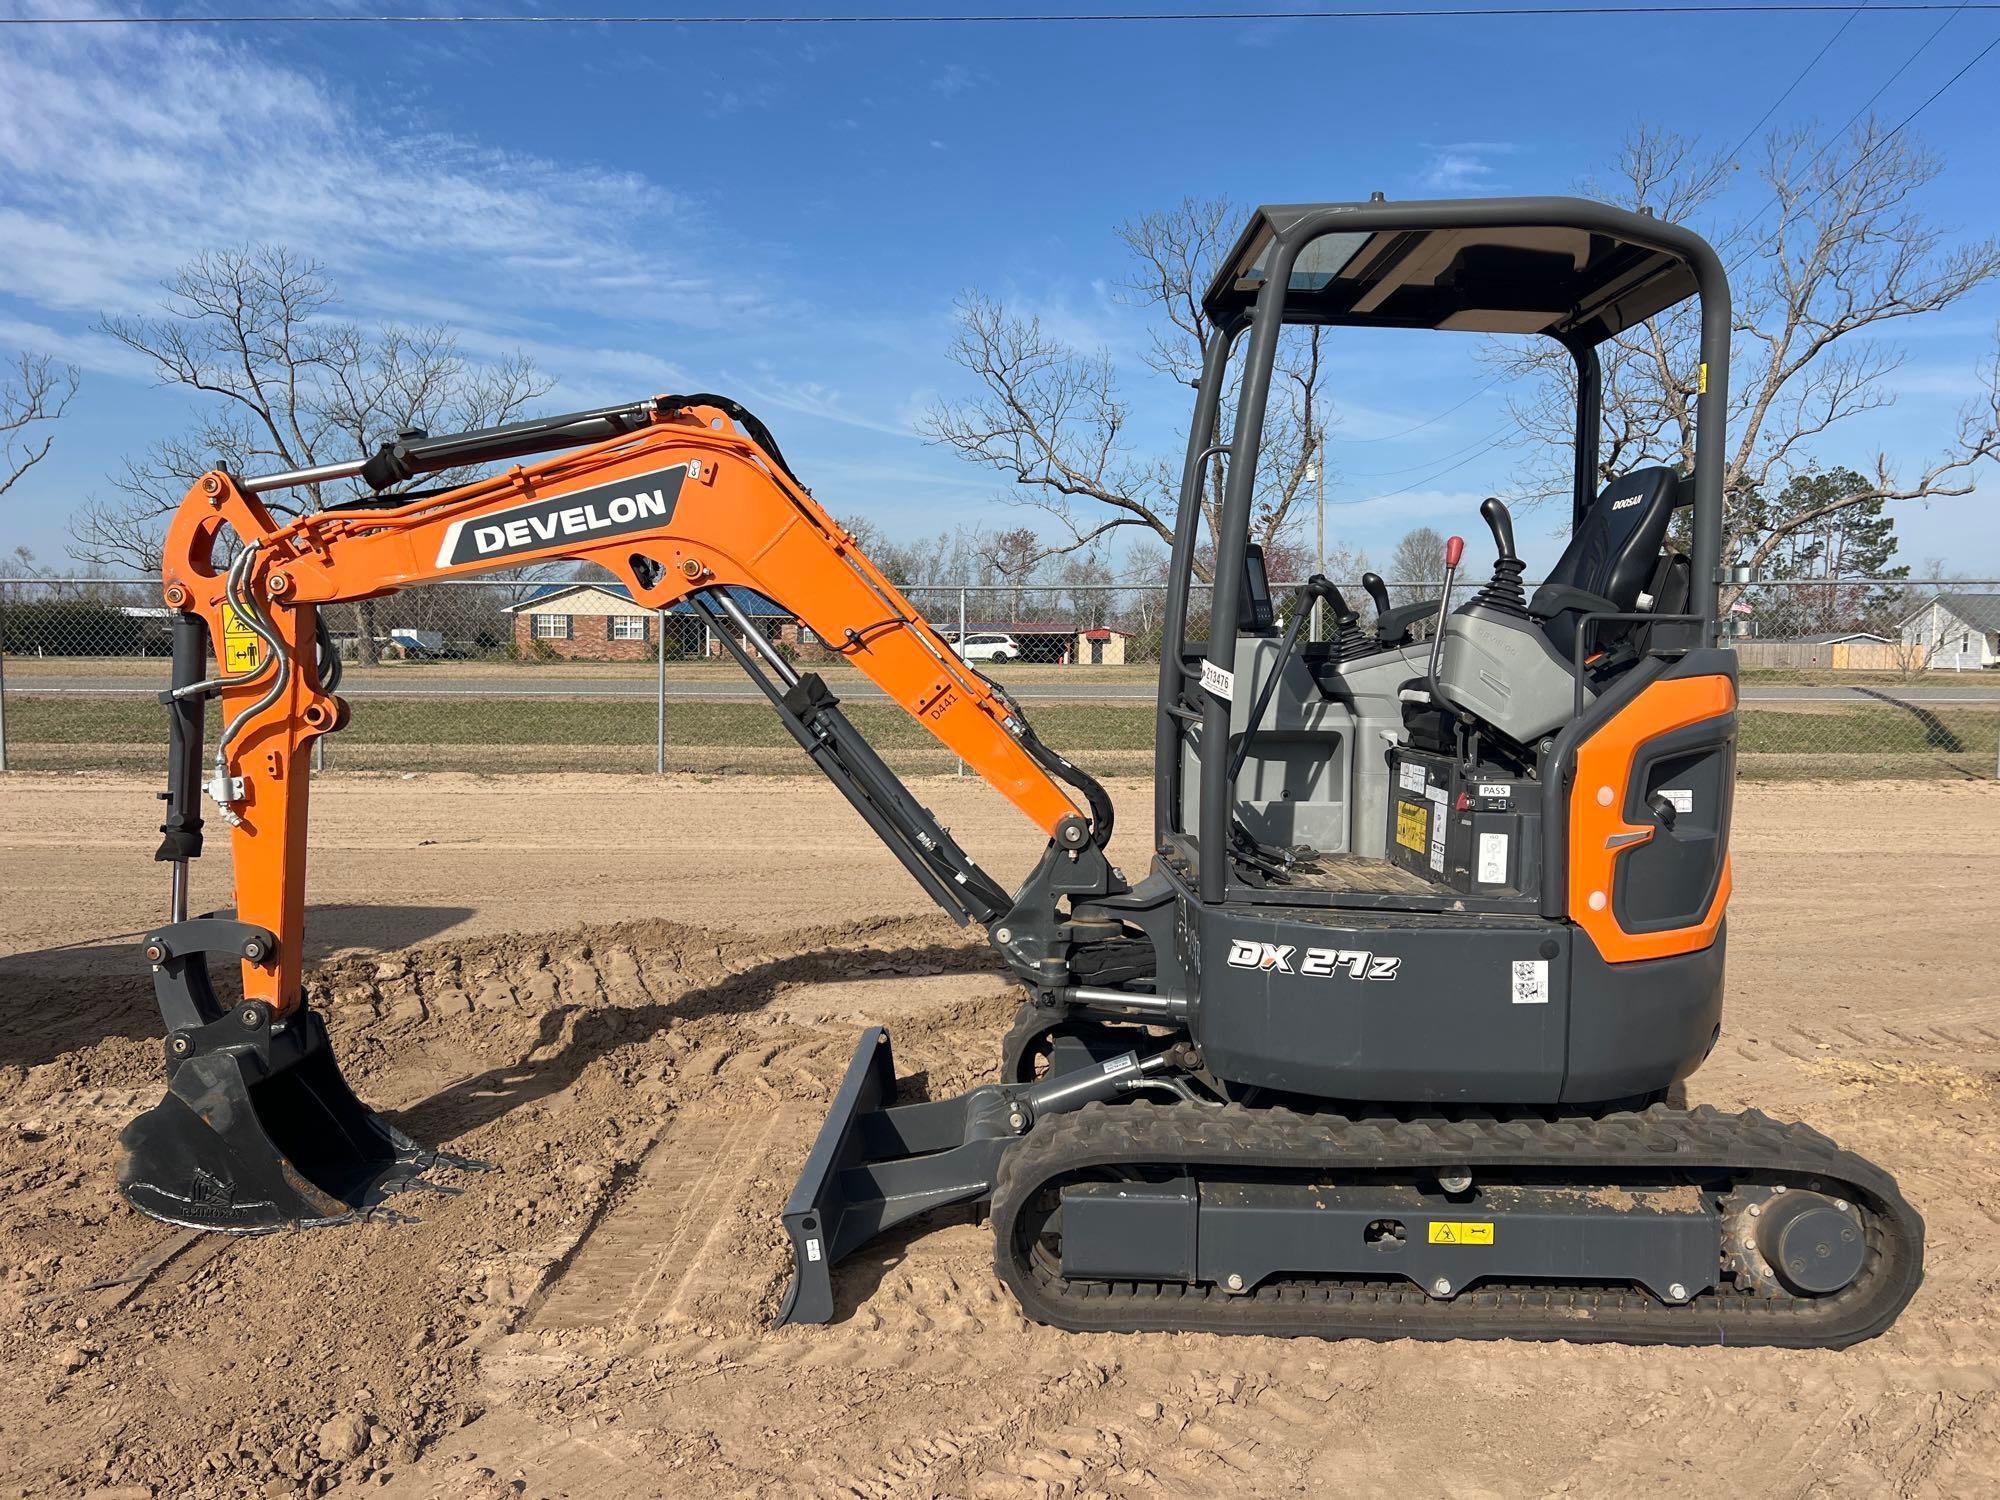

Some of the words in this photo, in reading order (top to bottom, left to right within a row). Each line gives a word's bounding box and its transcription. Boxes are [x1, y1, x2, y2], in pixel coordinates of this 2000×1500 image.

[1612, 494, 1643, 510] DOOSAN
[474, 489, 666, 553] DEVELON
[1206, 667, 1229, 688] 213476
[930, 693, 958, 720] D441
[1483, 786, 1506, 795] PASS
[1227, 939, 1297, 974] DX
